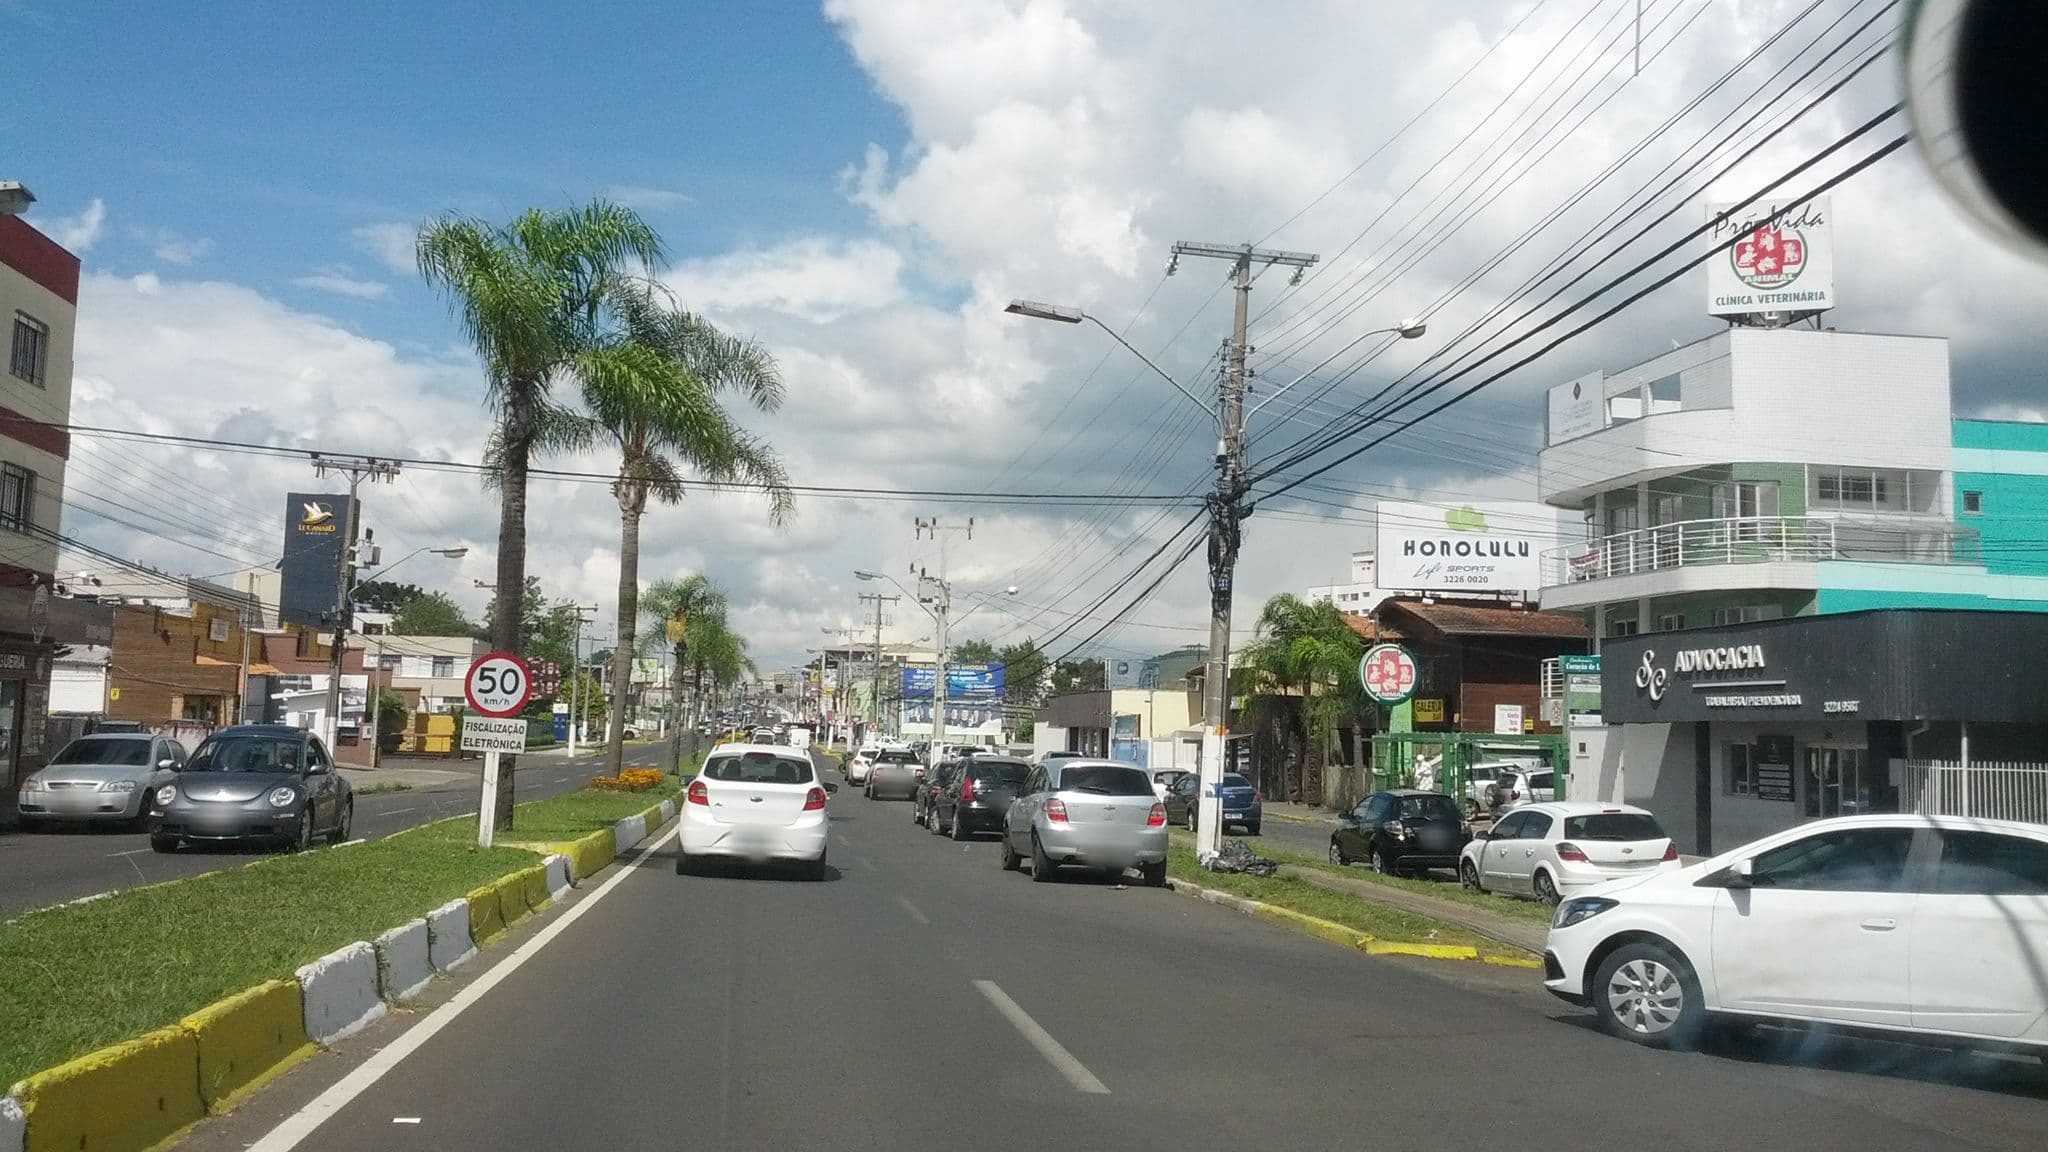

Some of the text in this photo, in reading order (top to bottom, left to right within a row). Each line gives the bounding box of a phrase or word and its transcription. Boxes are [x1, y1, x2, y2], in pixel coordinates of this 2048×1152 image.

[1771, 203, 1825, 231] Vida
[1743, 274, 1796, 283] ANIMAL
[1715, 290, 1826, 306] CLÍNICA VETERINÁRIA
[1403, 540, 1529, 557] HONOLULU
[1447, 565, 1495, 573] SPORTS
[1443, 575, 1489, 584] 3226 0020
[1674, 645, 1765, 672] ADVOCACIA
[478, 667, 520, 695] 50
[484, 697, 510, 705] km/h
[465, 721, 525, 736] FISCALIZAÇÃO
[463, 737, 522, 750] ELETRÔNICA
